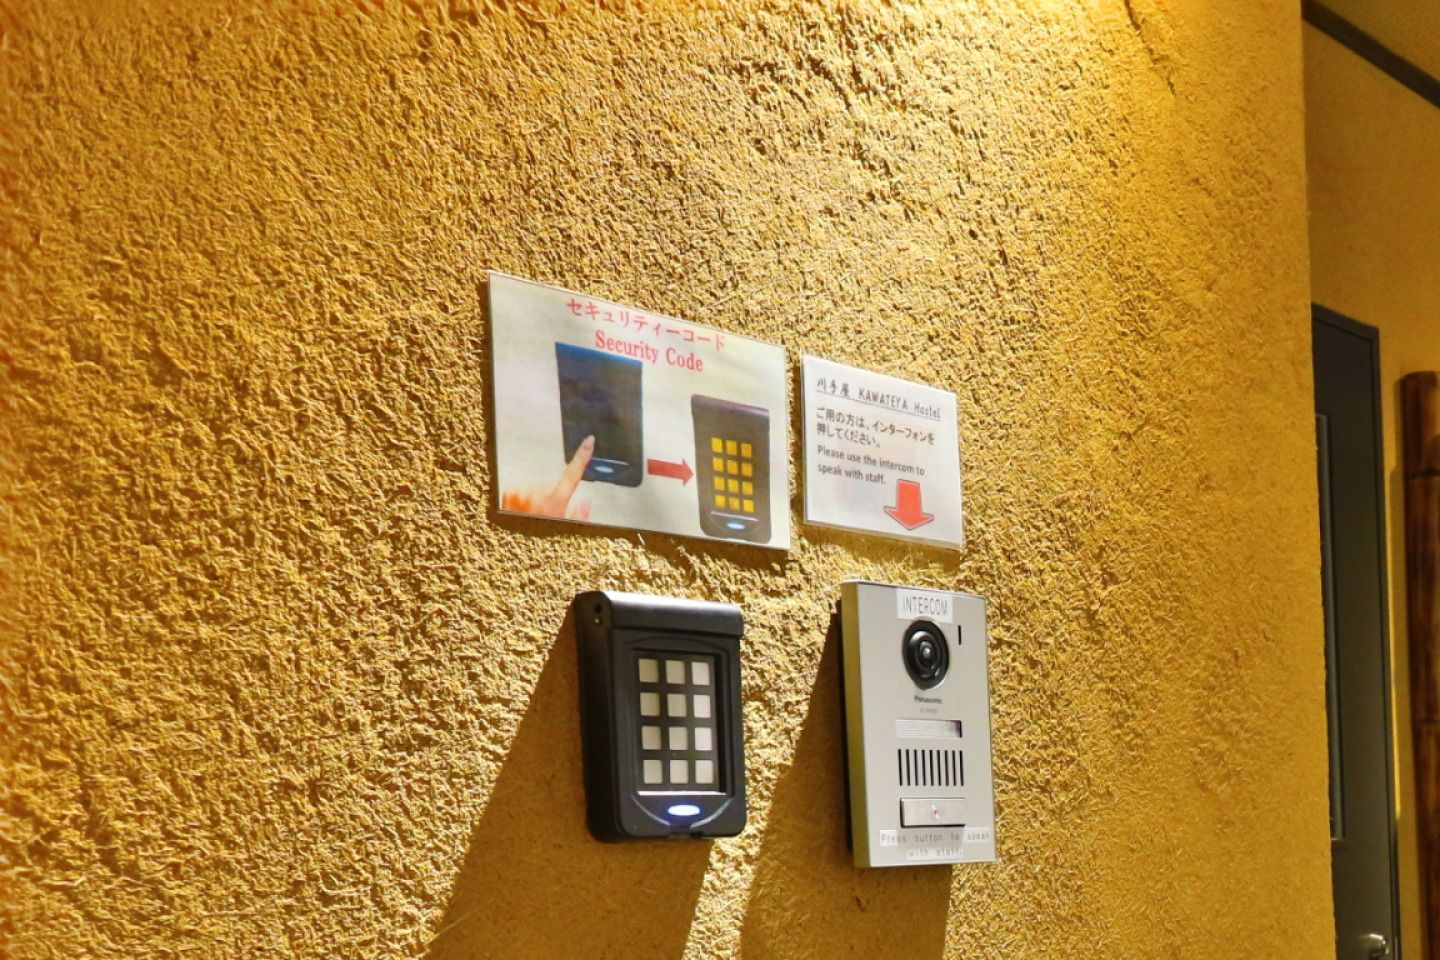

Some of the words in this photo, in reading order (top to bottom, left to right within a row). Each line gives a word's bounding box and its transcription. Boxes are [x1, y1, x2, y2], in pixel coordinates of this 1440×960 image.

[566, 299, 725, 351] セキュリティーコード
[595, 330, 659, 364] Security
[666, 347, 703, 372] Code
[859, 387, 908, 411] KAWATEYA
[914, 402, 940, 418] Hostel
[817, 445, 845, 460] Please
[848, 454, 861, 464] use
[863, 454, 877, 466] the
[880, 458, 915, 474] intercom
[916, 467, 925, 476] to
[817, 464, 842, 476] speak
[844, 468, 863, 480] with
[865, 472, 886, 484] staff.
[904, 595, 948, 615] INTERCOM
[914, 833, 943, 843] button
